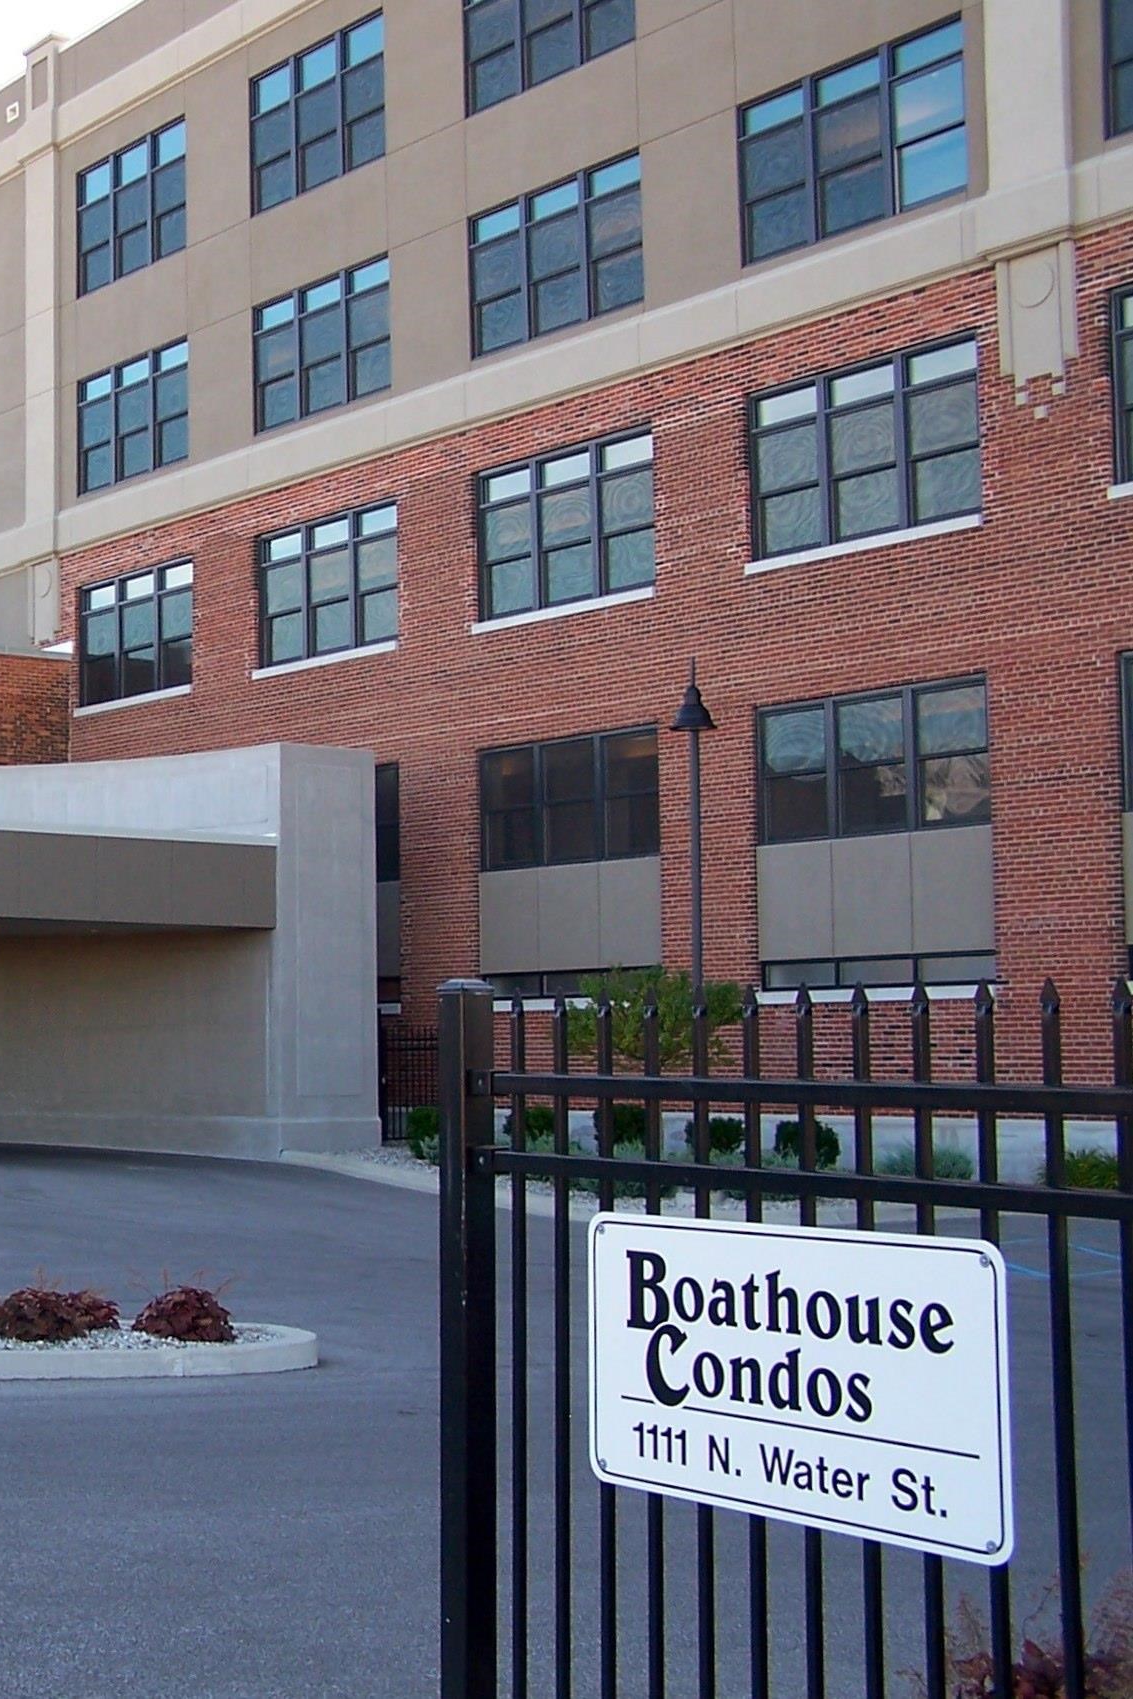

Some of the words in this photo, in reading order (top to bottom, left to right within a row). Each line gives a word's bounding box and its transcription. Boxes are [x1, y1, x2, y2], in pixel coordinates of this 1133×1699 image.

[625, 1249, 955, 1354] Boathouse
[645, 1323, 873, 1423] Condos
[632, 1421, 687, 1466] 1111
[708, 1434, 742, 1477] N.
[759, 1443, 870, 1501] Water
[891, 1468, 947, 1518] St.
